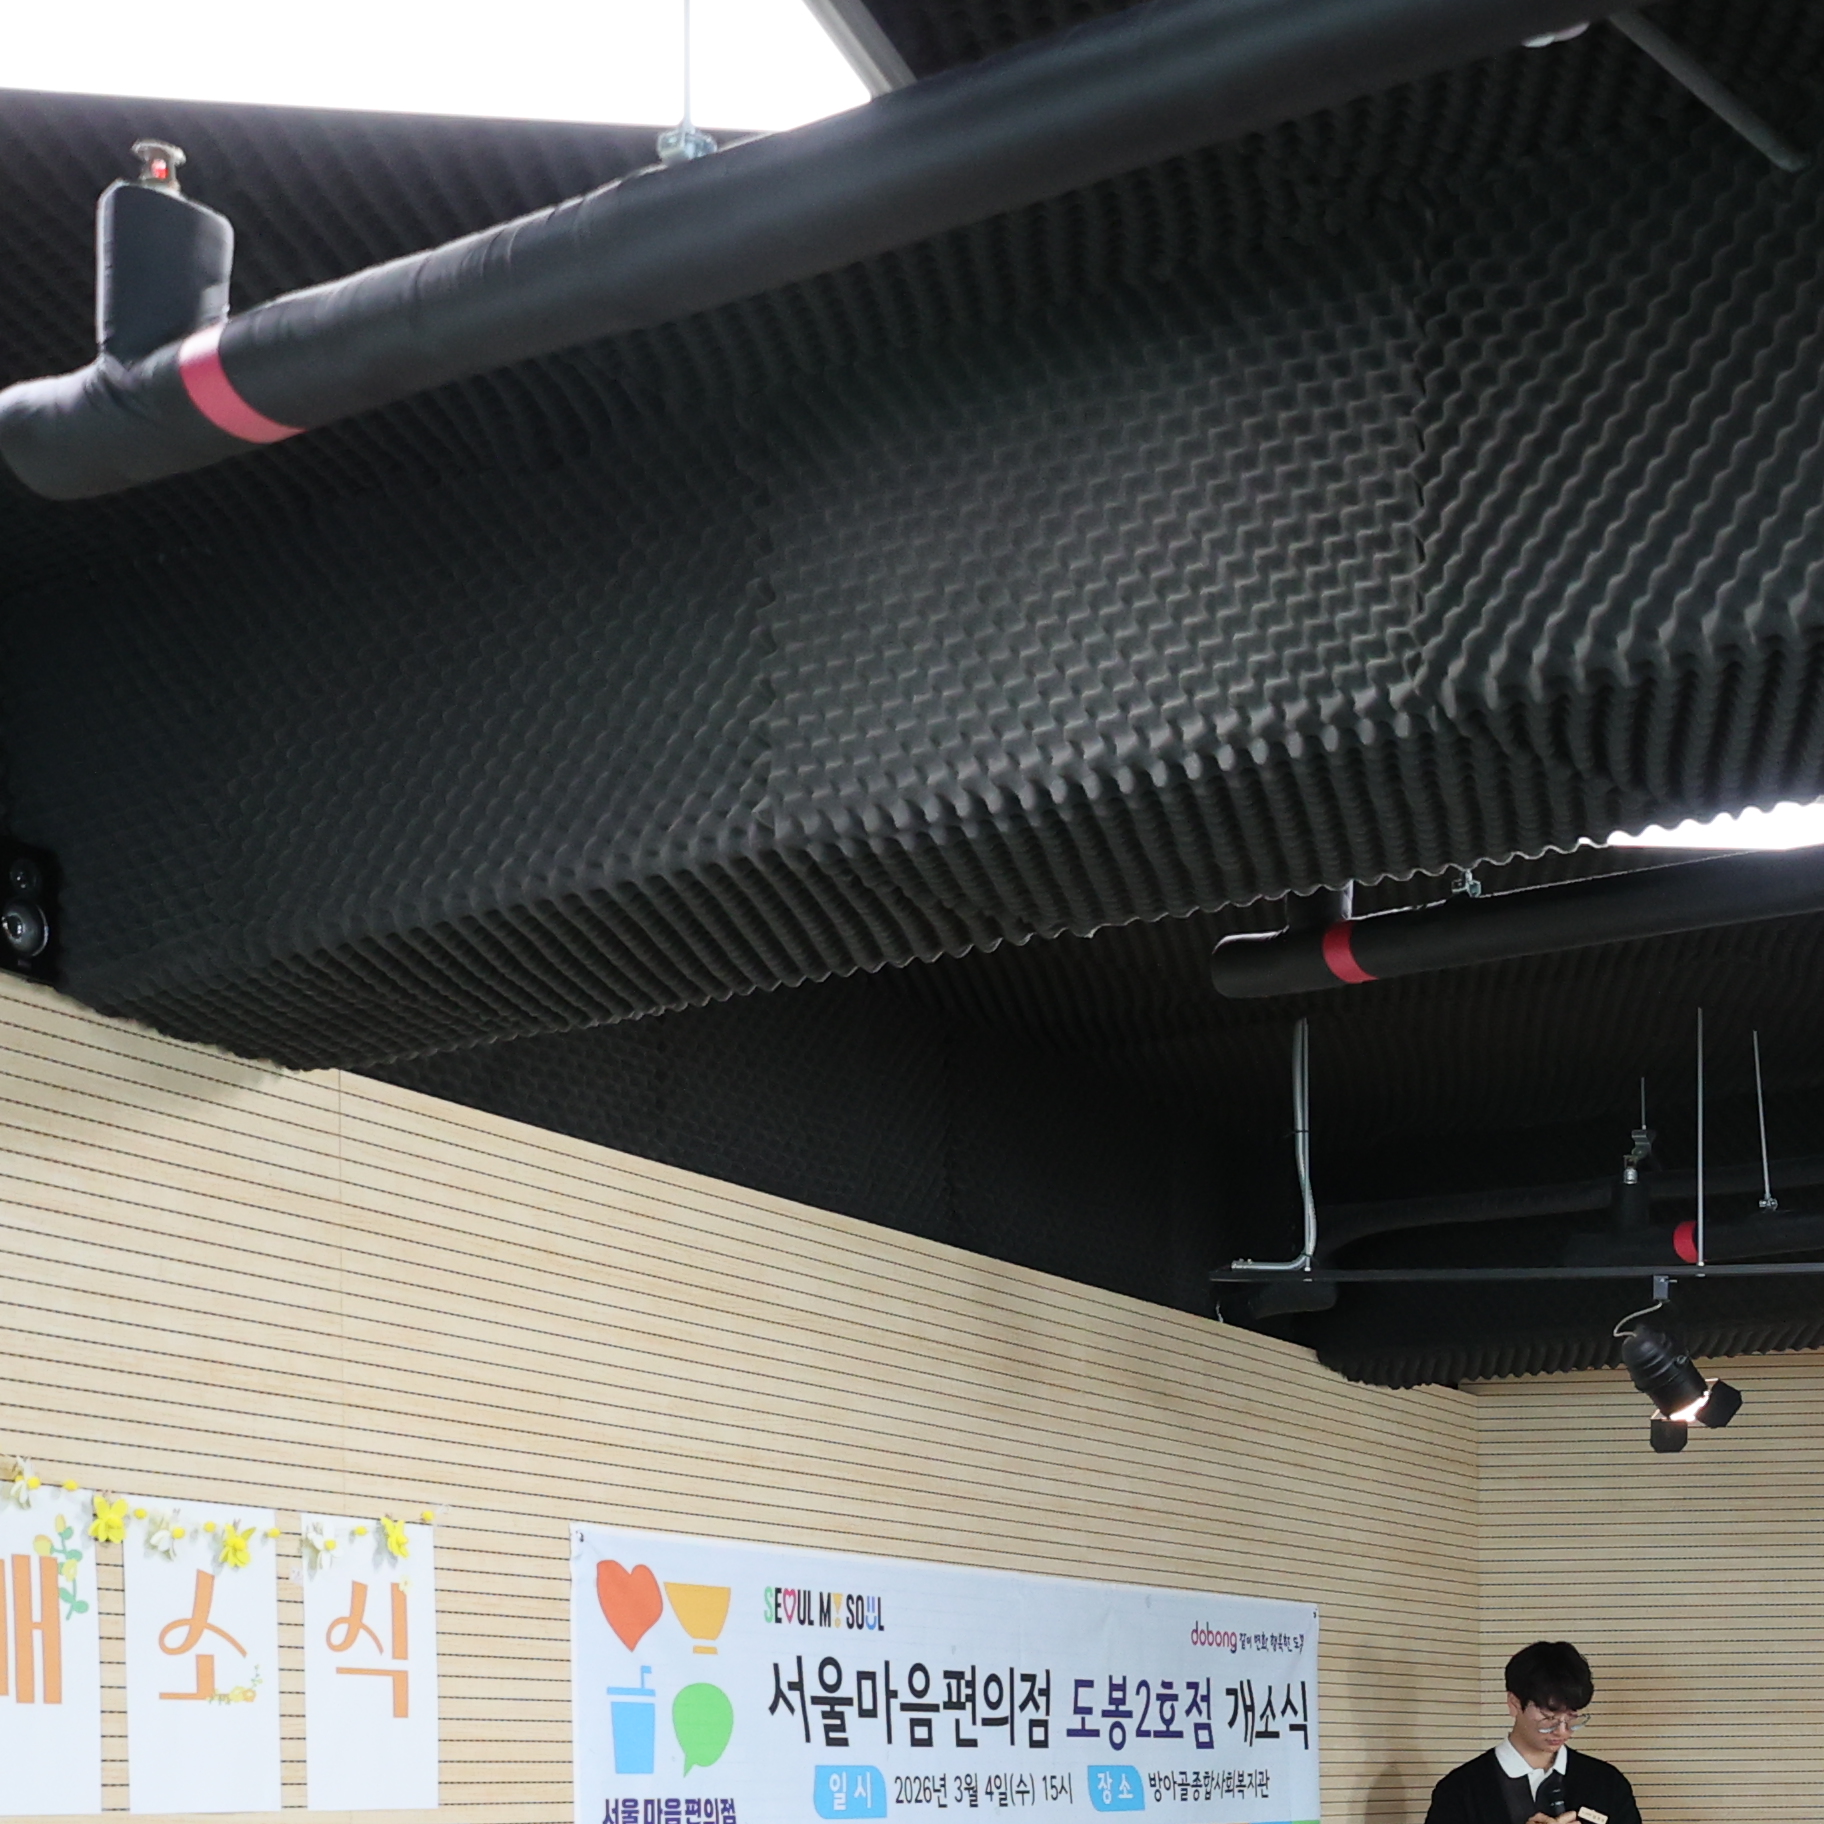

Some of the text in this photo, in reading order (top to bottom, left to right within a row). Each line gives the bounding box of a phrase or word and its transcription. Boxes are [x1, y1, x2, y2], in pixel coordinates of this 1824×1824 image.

[1191, 1621, 1237, 1654] dobong
[768, 1655, 1310, 1751] 서울마음편의점 도봉2호점 개소식
[828, 1769, 1271, 1811] 일시 2026년 3월 4일(수) 15시 장소 방아골종합사회복지관
